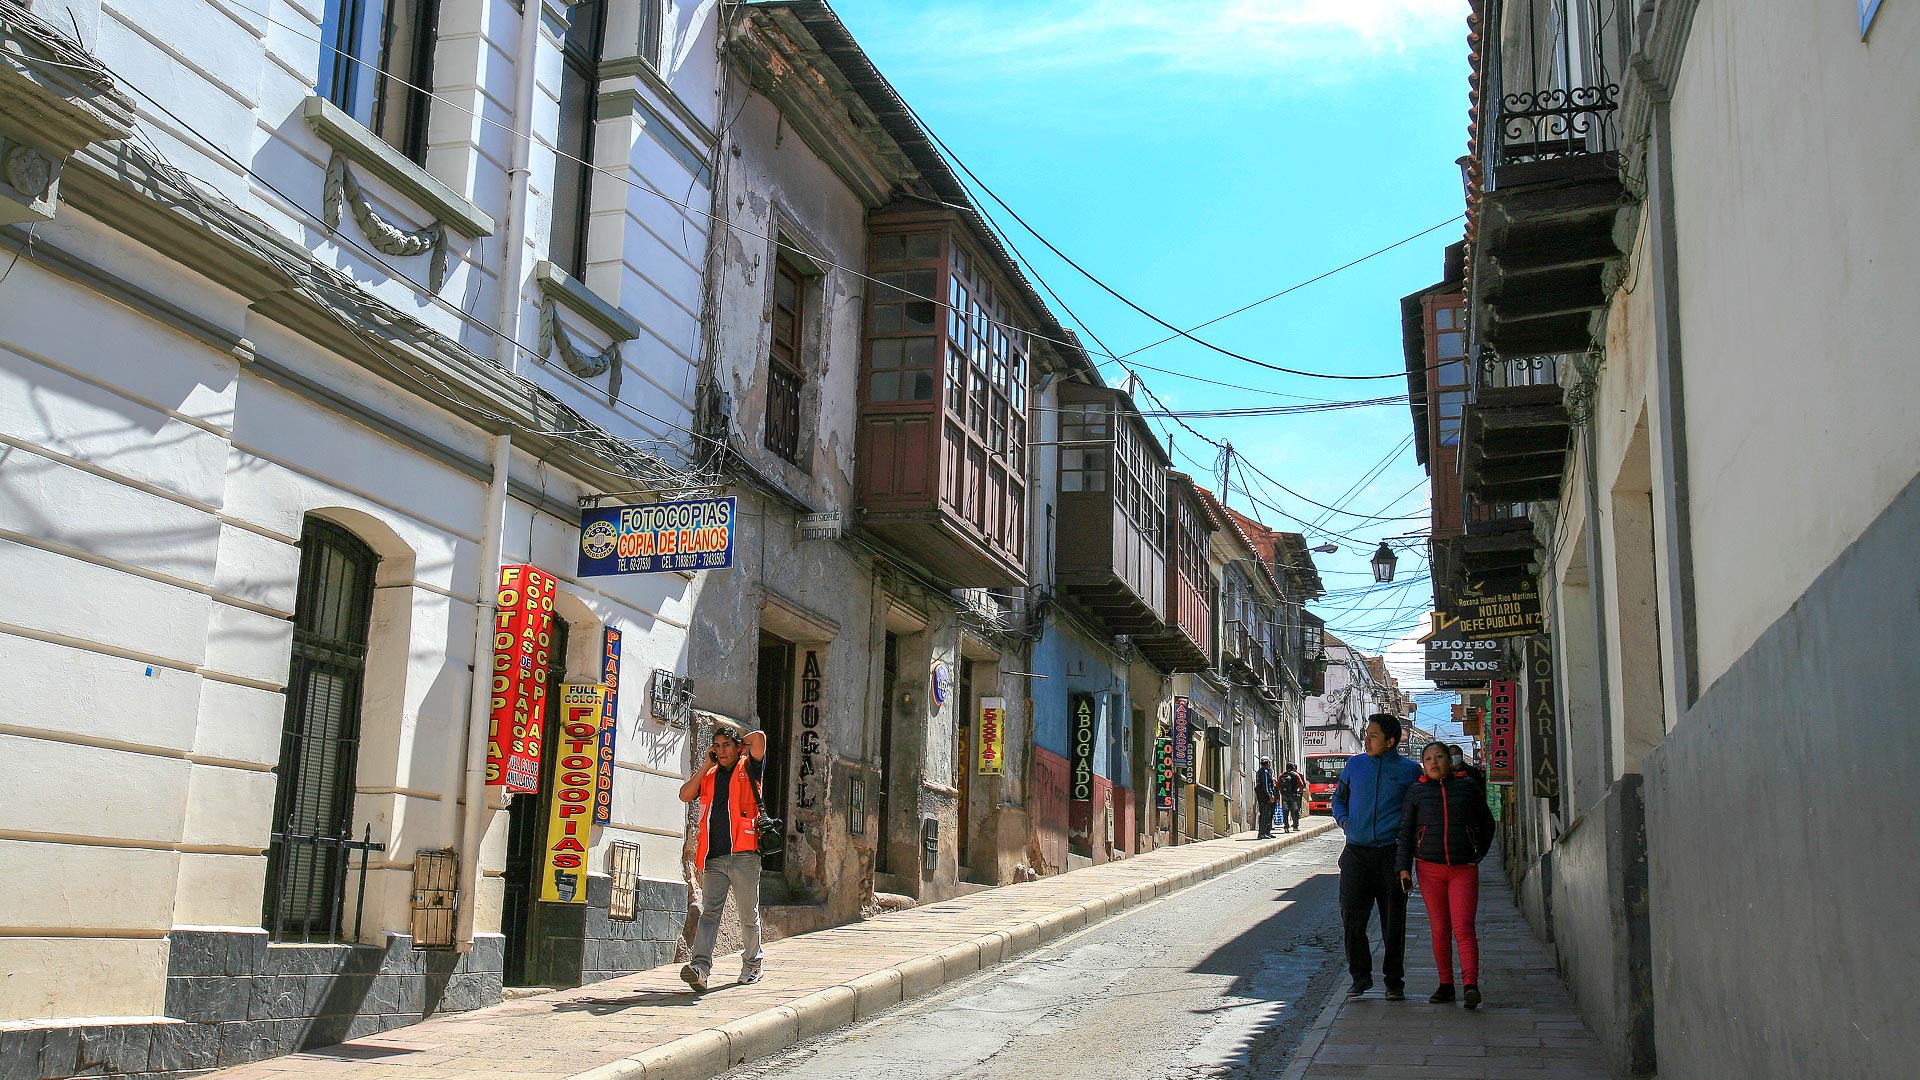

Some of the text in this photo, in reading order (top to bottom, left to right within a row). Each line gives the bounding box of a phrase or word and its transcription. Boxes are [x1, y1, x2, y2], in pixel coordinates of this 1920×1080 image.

[590, 527, 611, 536] COPY
[621, 503, 729, 532] FOTOCOPIAS
[619, 527, 727, 557] COPIA DE PLANOS
[521, 571, 541, 654] COPIAS
[1459, 598, 1479, 607] Roxana
[1479, 602, 1521, 617] NOTARIO
[1461, 619, 1472, 632] DE
[1473, 618, 1485, 631] FE
[1486, 614, 1524, 629] PUBLICA
[1431, 640, 1497, 649] PLOTEO
[1450, 651, 1474, 660] DE
[486, 568, 520, 781] FOTOCOPIAS
[520, 655, 532, 669] DE
[527, 577, 555, 758] FOTOCOPIAS
[1430, 661, 1498, 671] PLANOS
[565, 695, 602, 704] COLOR
[569, 686, 597, 694] FULL
[512, 668, 532, 753] PLANOS
[597, 630, 619, 819] PLASTIFICADOS
[982, 708, 997, 760] FOTOCOPIAS
[1176, 705, 1187, 759] ABOGADOS
[1075, 700, 1091, 798] ABOGADO
[551, 707, 595, 868] FOTOCOPIAS
